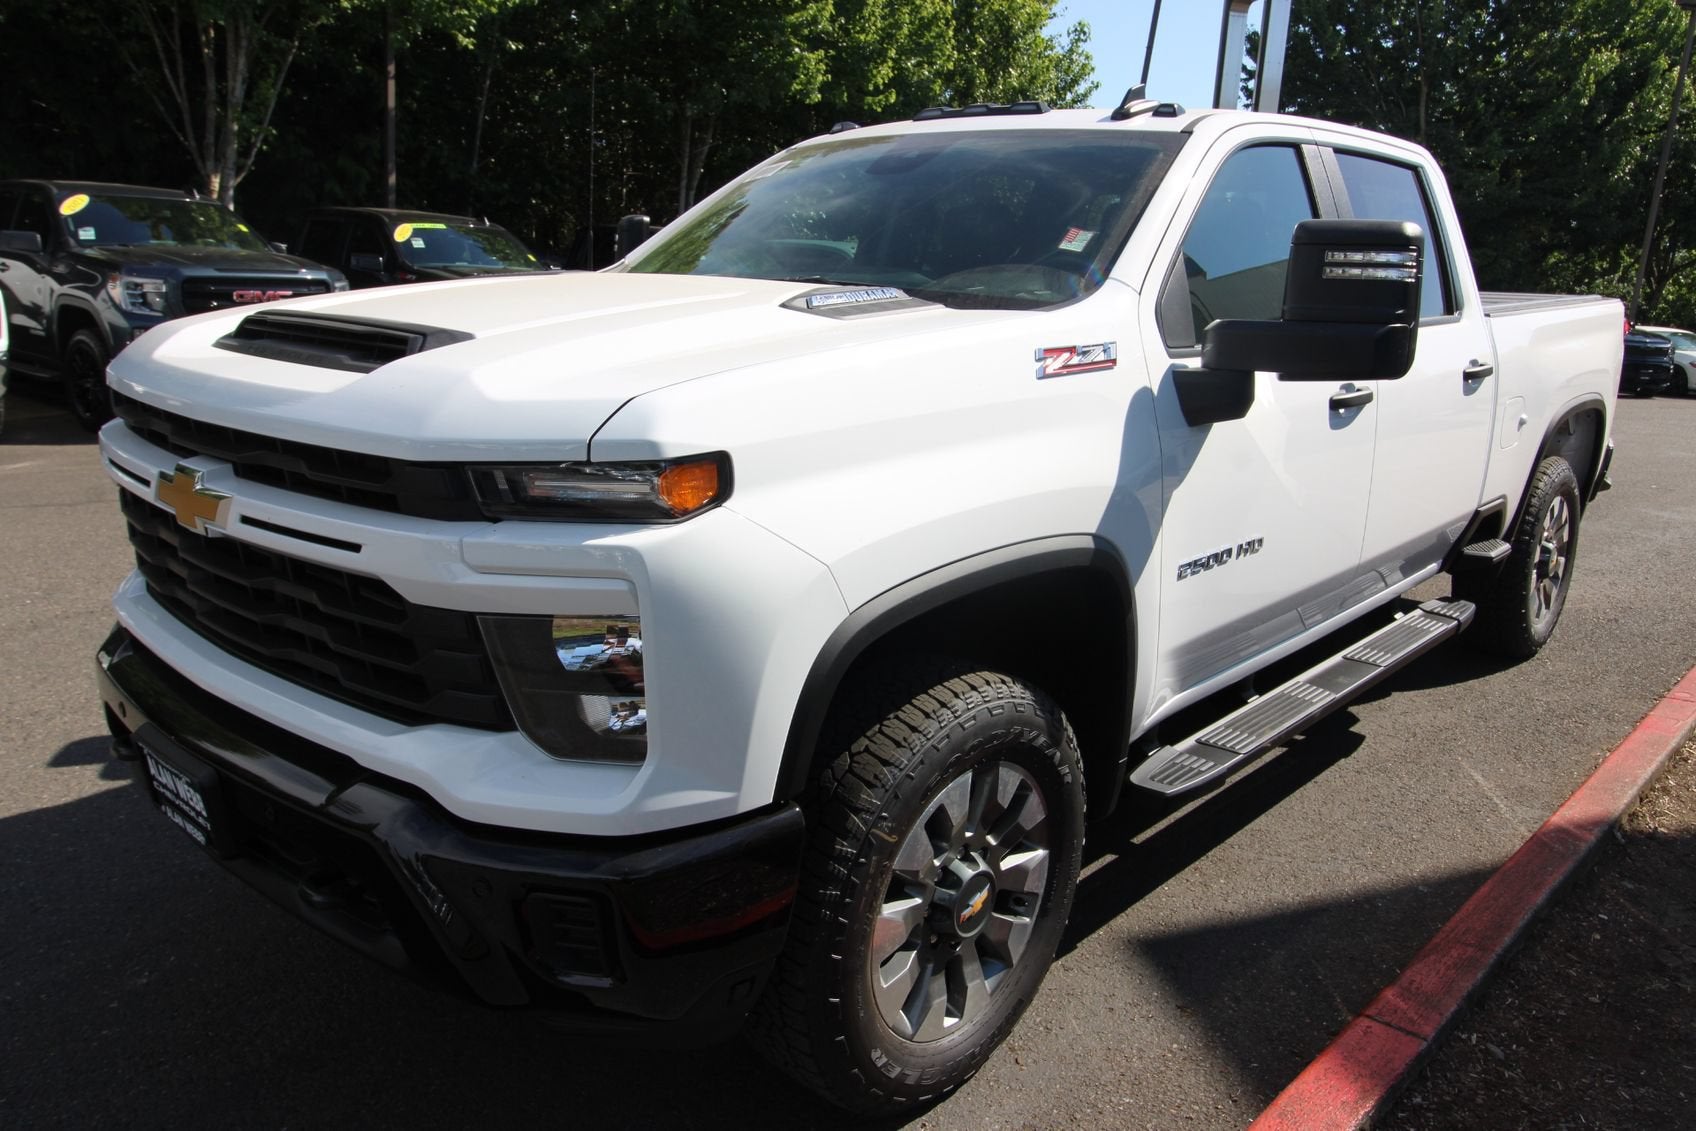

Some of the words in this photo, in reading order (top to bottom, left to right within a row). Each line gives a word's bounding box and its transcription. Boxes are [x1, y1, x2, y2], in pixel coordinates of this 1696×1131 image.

[232, 290, 293, 302] GMC
[1035, 341, 1117, 380] Z71
[1176, 546, 1233, 582] 2500
[1235, 536, 1264, 561] HD
